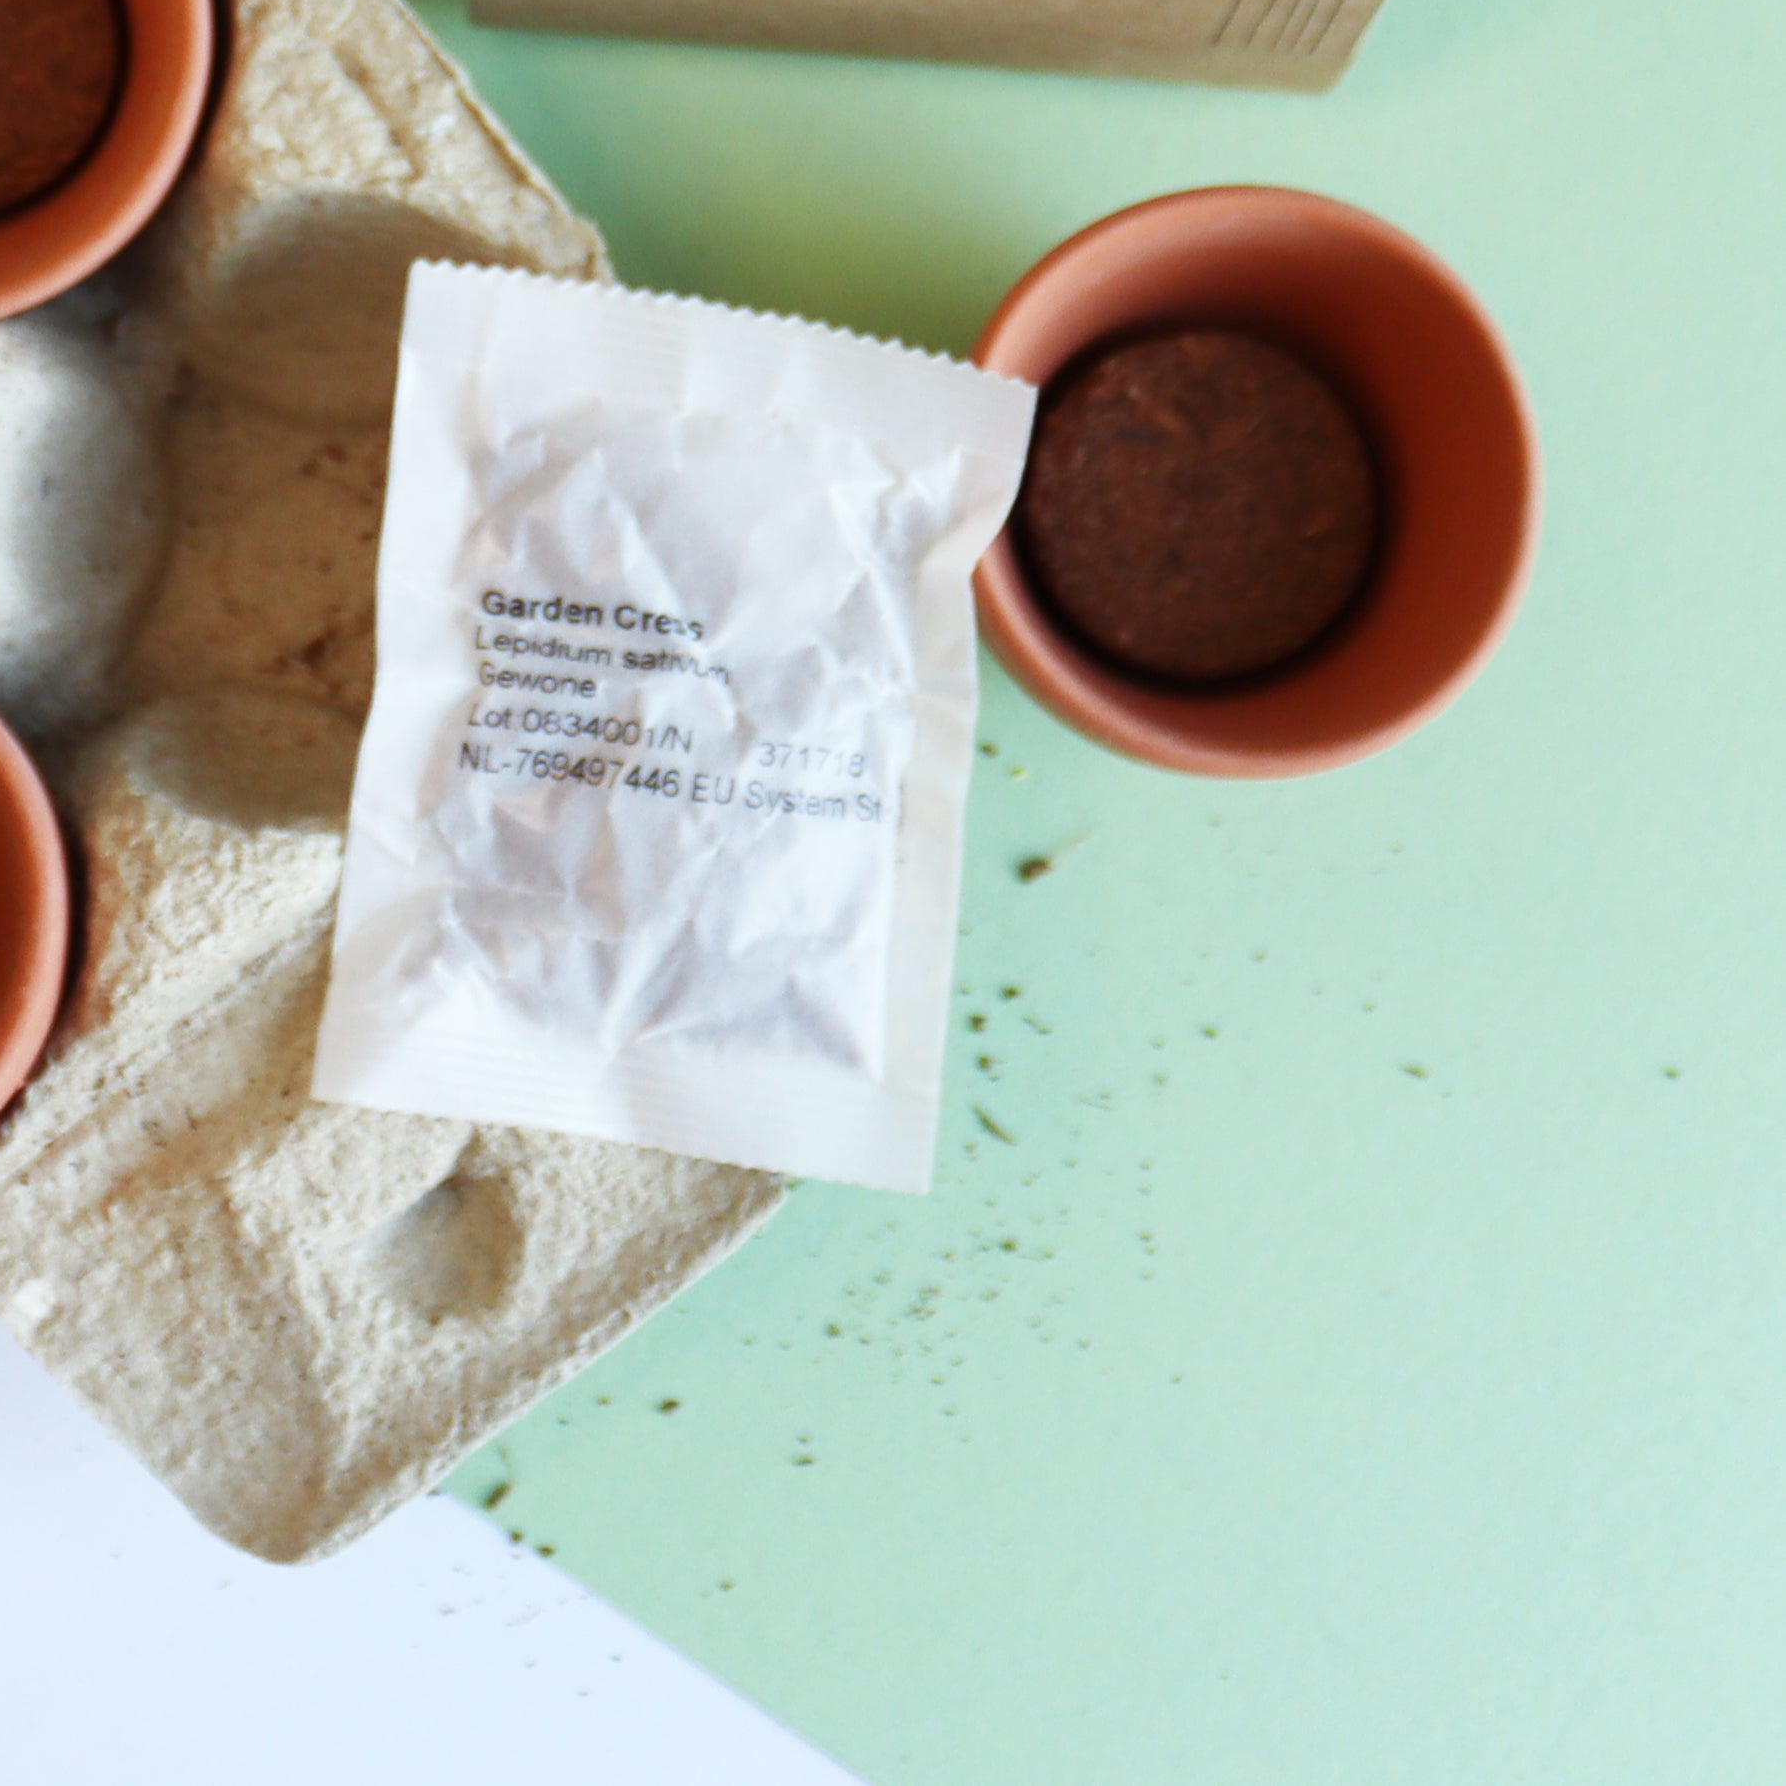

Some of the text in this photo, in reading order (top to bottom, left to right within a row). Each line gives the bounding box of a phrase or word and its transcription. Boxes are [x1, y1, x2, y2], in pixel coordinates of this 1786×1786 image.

[481, 590, 704, 641] Garden Cress
[475, 624, 611, 666] Lepidium
[479, 661, 597, 698] Gewone
[467, 703, 512, 731] Lot
[691, 773, 735, 805] EU
[745, 780, 846, 818] System
